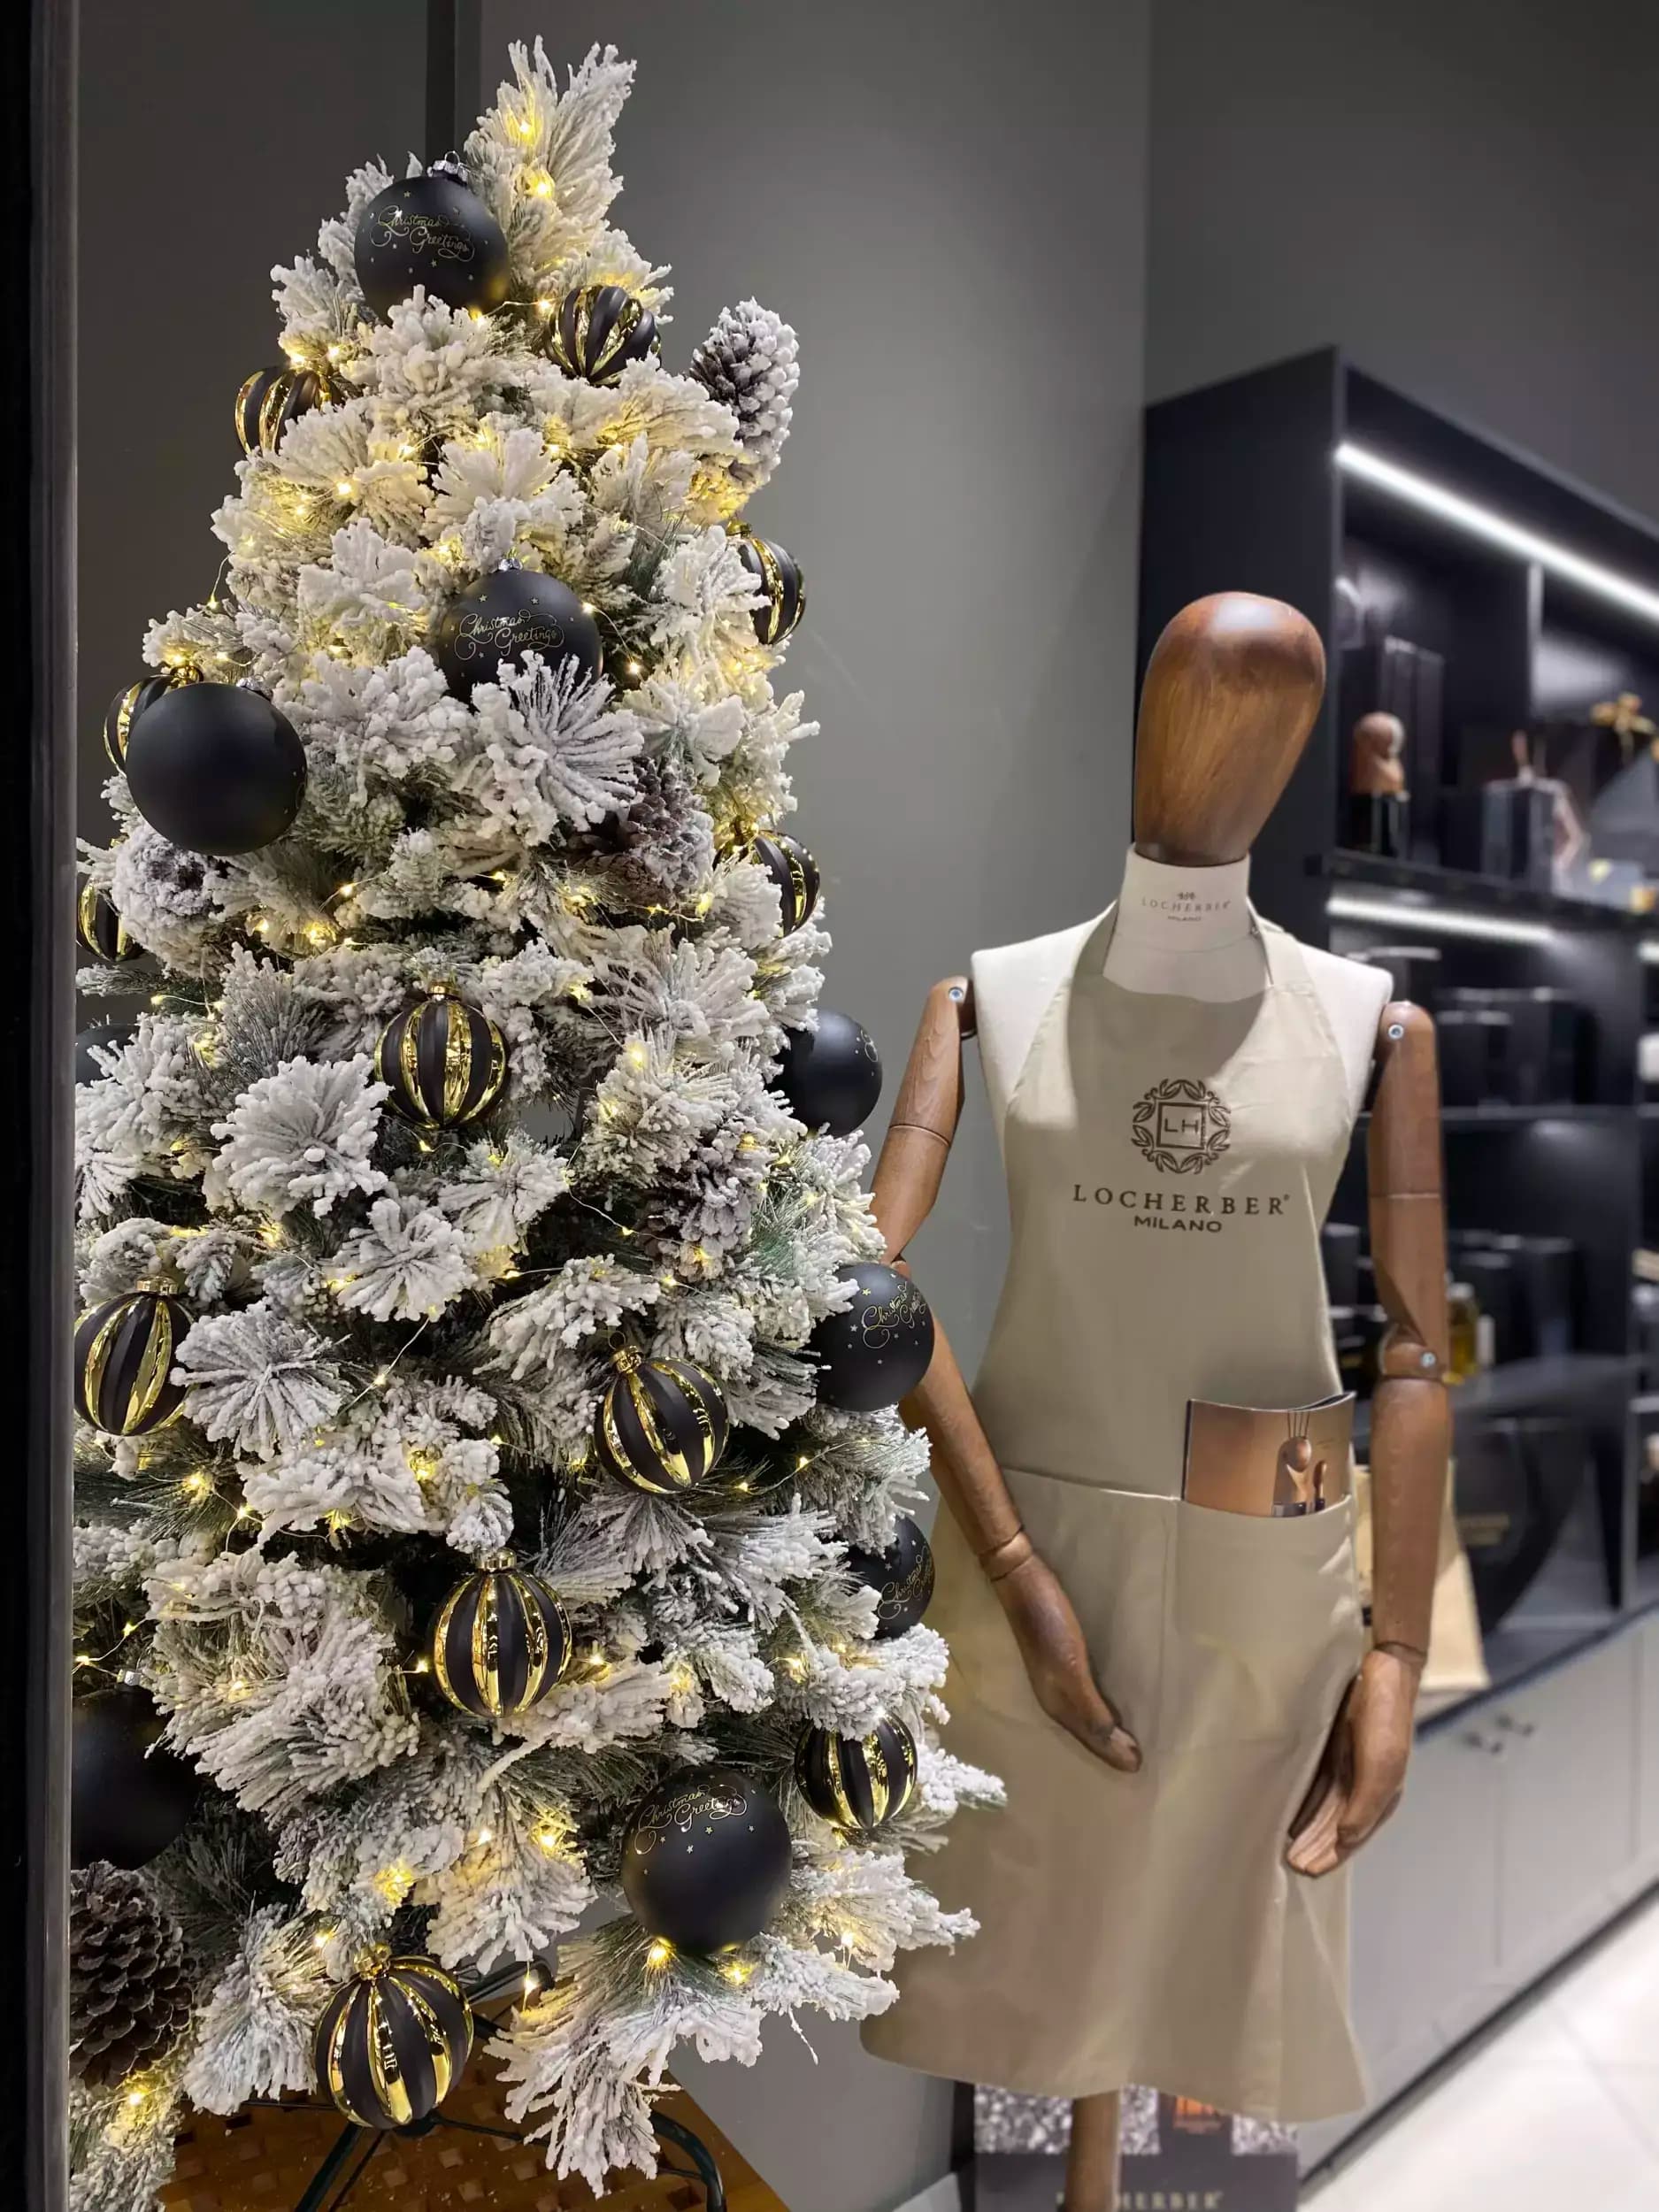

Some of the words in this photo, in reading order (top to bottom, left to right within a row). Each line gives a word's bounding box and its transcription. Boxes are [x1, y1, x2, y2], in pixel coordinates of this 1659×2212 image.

[410, 227, 475, 262] Greetings
[455, 611, 532, 653] Christmas
[495, 625, 565, 657] Greetings
[1164, 1118, 1200, 1134] LH
[1133, 1215, 1223, 1233] MILANO
